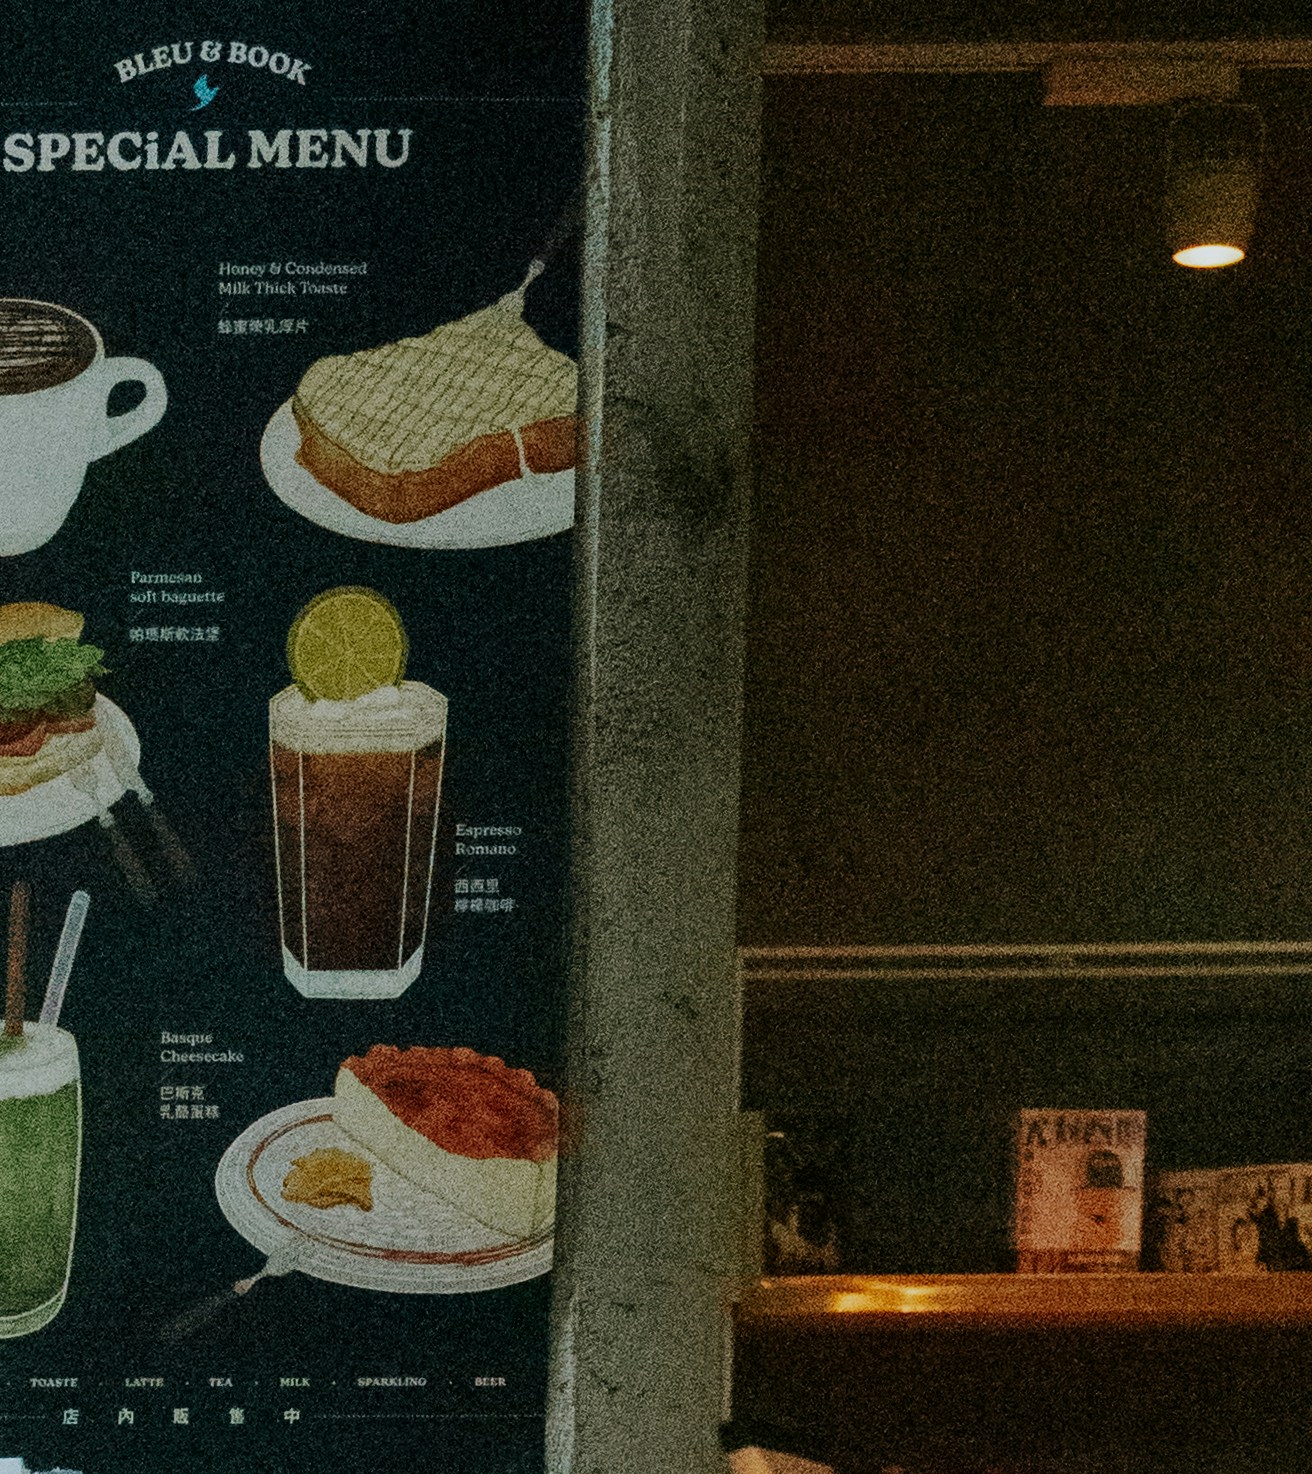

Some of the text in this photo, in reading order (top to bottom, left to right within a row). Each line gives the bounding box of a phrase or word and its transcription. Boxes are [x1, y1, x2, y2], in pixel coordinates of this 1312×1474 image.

[115, 39, 313, 87] BLEU & BOOK
[247, 128, 413, 169] MENU
[219, 262, 266, 280] Honey
[285, 261, 367, 277] Condensed
[219, 281, 348, 297] Milk Thick Toaste
[131, 570, 203, 586] Parmesan
[130, 588, 225, 608] soft baguette
[455, 824, 522, 842] Espresso
[455, 842, 517, 857] Romano
[160, 1030, 213, 1049] Basque
[160, 1049, 243, 1065] Cheesecake
[30, 1377, 78, 1390] TOASTE
[125, 1377, 164, 1390] LATTE
[209, 1376, 233, 1389] TEA
[279, 1376, 311, 1389] MILK
[357, 1375, 427, 1389] SPARKLING
[475, 1376, 507, 1389] BEER
